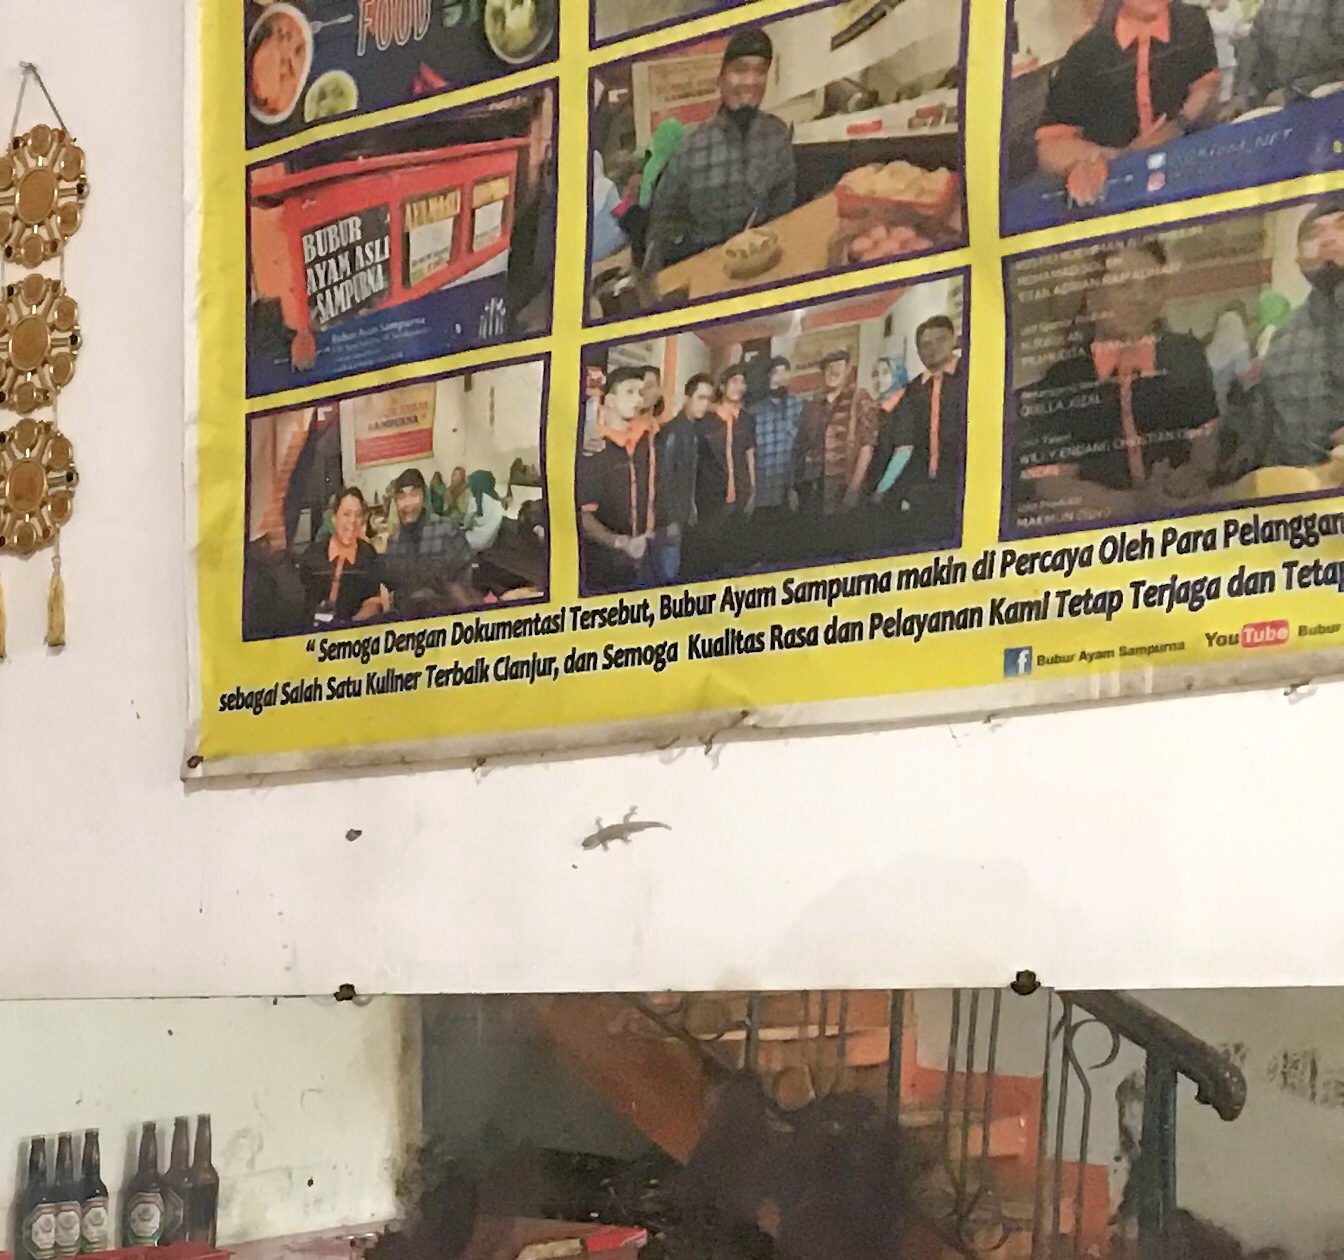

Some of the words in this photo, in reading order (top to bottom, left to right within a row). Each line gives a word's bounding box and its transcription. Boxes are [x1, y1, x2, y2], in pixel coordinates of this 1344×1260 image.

[302, 215, 362, 264] BUBUR
[306, 249, 351, 296] AYAM
[317, 636, 381, 664] Semoga
[384, 628, 446, 658] Dengan
[451, 606, 566, 647] Dokumentasi
[570, 598, 655, 633] Tersebut,
[659, 588, 717, 622] Bubur
[719, 584, 777, 618] Ayam
[780, 569, 892, 608] Sampurna
[897, 552, 967, 593] makin
[971, 549, 996, 582] di
[999, 545, 1094, 579] Percaya
[1098, 526, 1154, 566] Oleh
[1161, 523, 1217, 558] Para
[1222, 512, 1344, 550] Pelanggan
[218, 682, 280, 716] sebagai
[280, 676, 323, 706] Salah
[326, 675, 363, 702] Satu
[365, 667, 422, 697] Kuliner
[425, 657, 490, 690] Terbaik
[492, 650, 560, 686] Cianjur,
[563, 646, 599, 675] dan
[601, 640, 679, 673] Semoga
[687, 628, 766, 661] Kualitas
[769, 620, 820, 651] Rasa
[823, 614, 864, 646] dan
[868, 603, 984, 644] Pelayanan
[989, 590, 1049, 628] Kami
[1055, 587, 1124, 622] Tetap
[1129, 574, 1223, 614] Terjaga
[1226, 565, 1276, 598] dan
[1036, 651, 1076, 667] Bubur
[1078, 649, 1115, 664] Ayam
